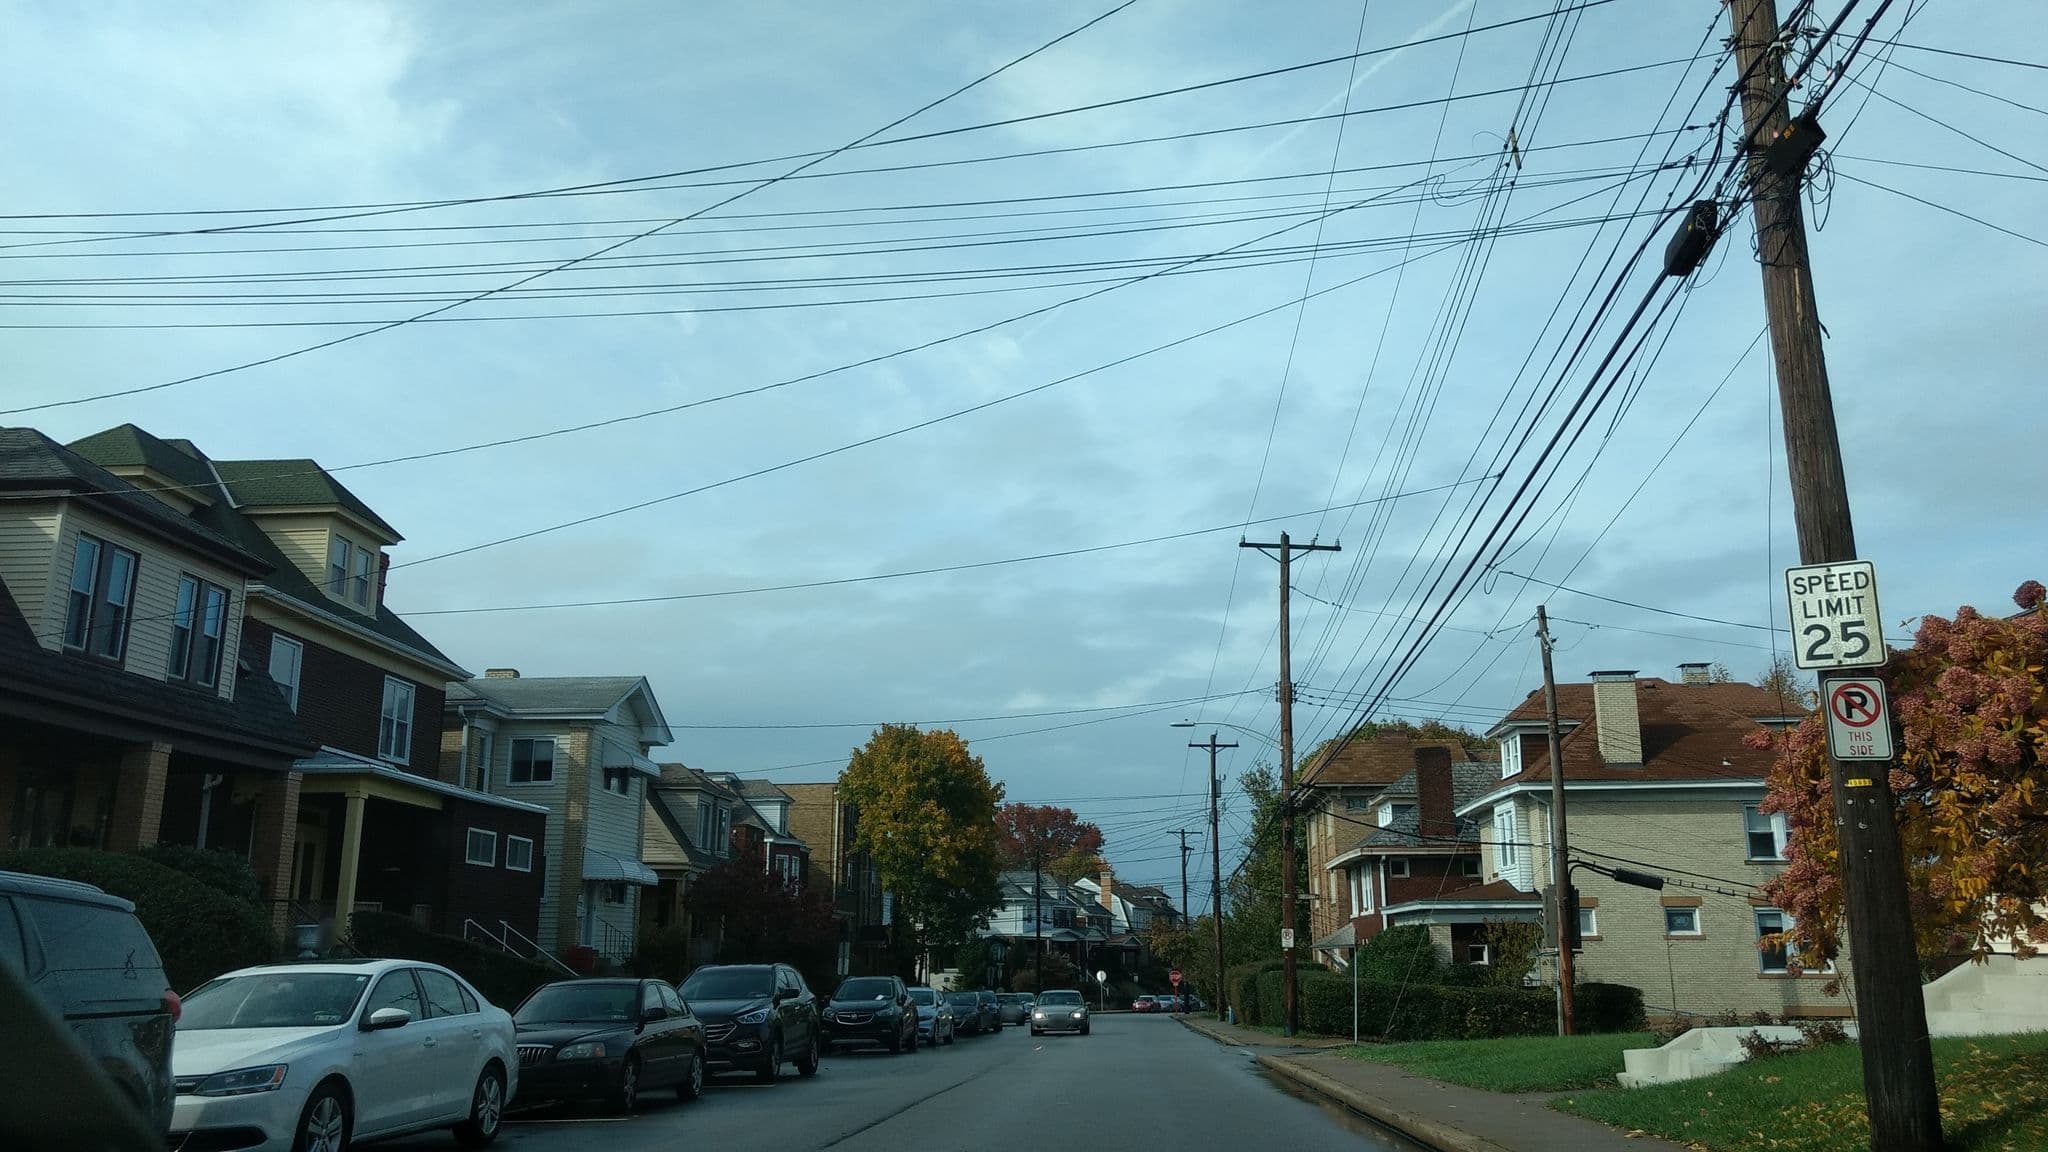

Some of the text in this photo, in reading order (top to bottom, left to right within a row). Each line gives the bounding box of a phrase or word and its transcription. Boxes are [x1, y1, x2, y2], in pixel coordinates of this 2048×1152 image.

[1793, 571, 1869, 595] SPEED
[1803, 596, 1864, 619] LIMIT
[1803, 620, 1870, 661] 25
[1848, 731, 1873, 742] THIS
[1850, 745, 1875, 756] SIDE
